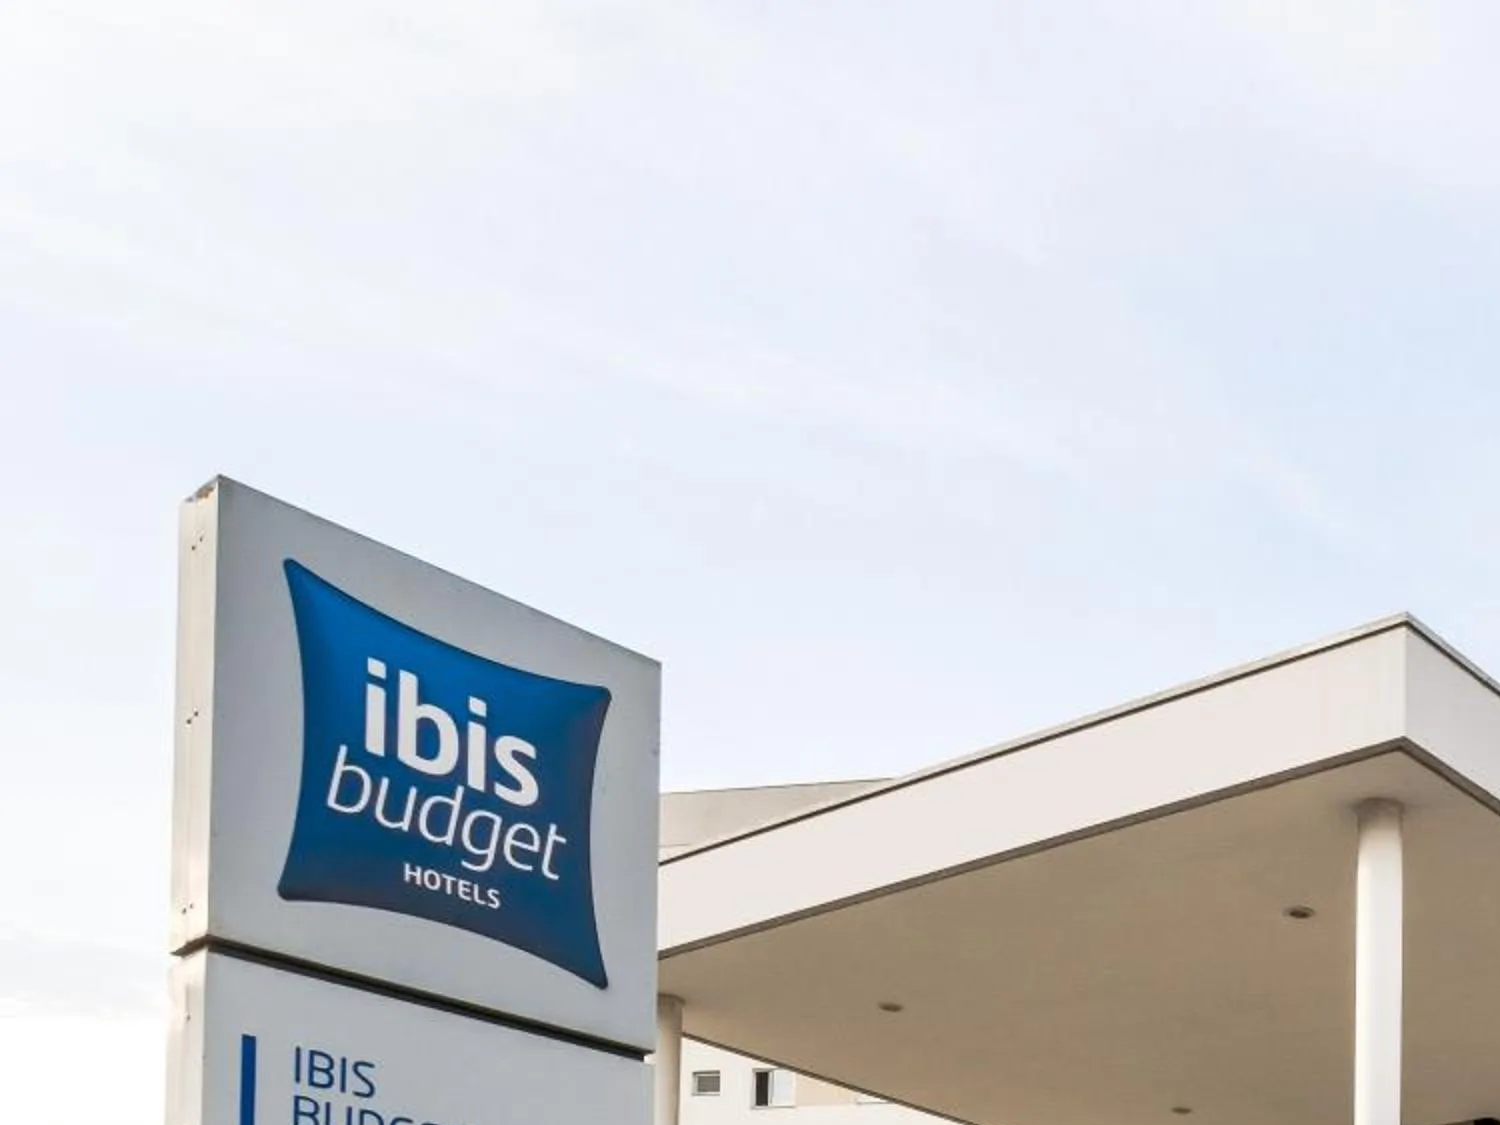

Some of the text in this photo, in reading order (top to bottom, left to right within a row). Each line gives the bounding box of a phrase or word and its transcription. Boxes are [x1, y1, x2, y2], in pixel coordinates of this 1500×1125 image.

[365, 657, 539, 807] ibis
[327, 744, 568, 881] budget
[403, 863, 501, 909] HOTELS
[294, 1046, 376, 1099] IBIS
